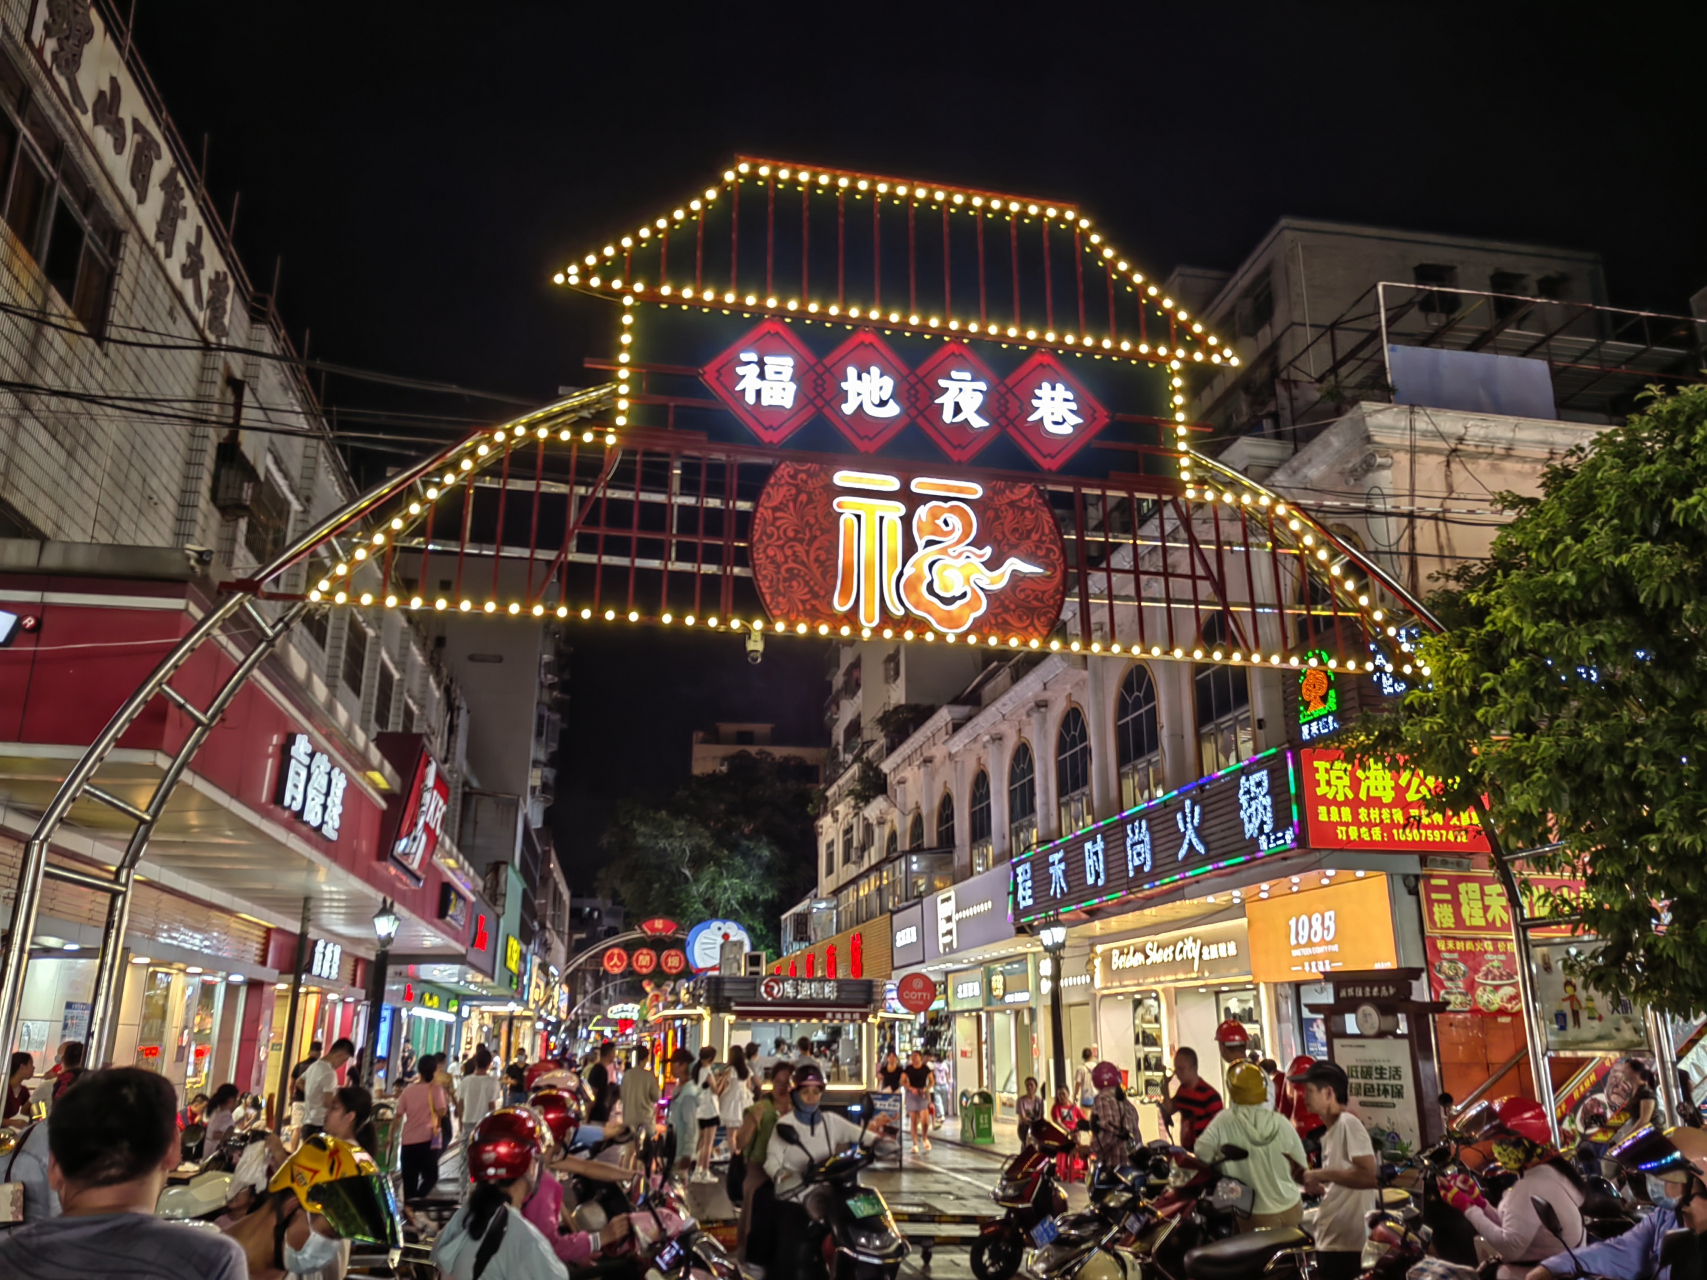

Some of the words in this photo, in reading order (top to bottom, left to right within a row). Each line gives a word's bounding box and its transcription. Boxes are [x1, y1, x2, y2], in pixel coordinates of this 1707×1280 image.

[734, 351, 1085, 435] 福地夜巷
[284, 733, 347, 841] 肯德基
[425, 788, 448, 836] KFC
[1016, 769, 1274, 909] 程禾时尚火锅
[1430, 878, 1455, 928] 二楼
[1288, 910, 1336, 946] 1985
[1145, 941, 1174, 965] Shoes
[1175, 936, 1201, 972] City
[784, 979, 838, 1001] 库迪咖啡
[903, 991, 931, 1000] COTTI
[1346, 1064, 1402, 1081] 低碳生活
[1349, 1082, 1404, 1099] 绿色环保
